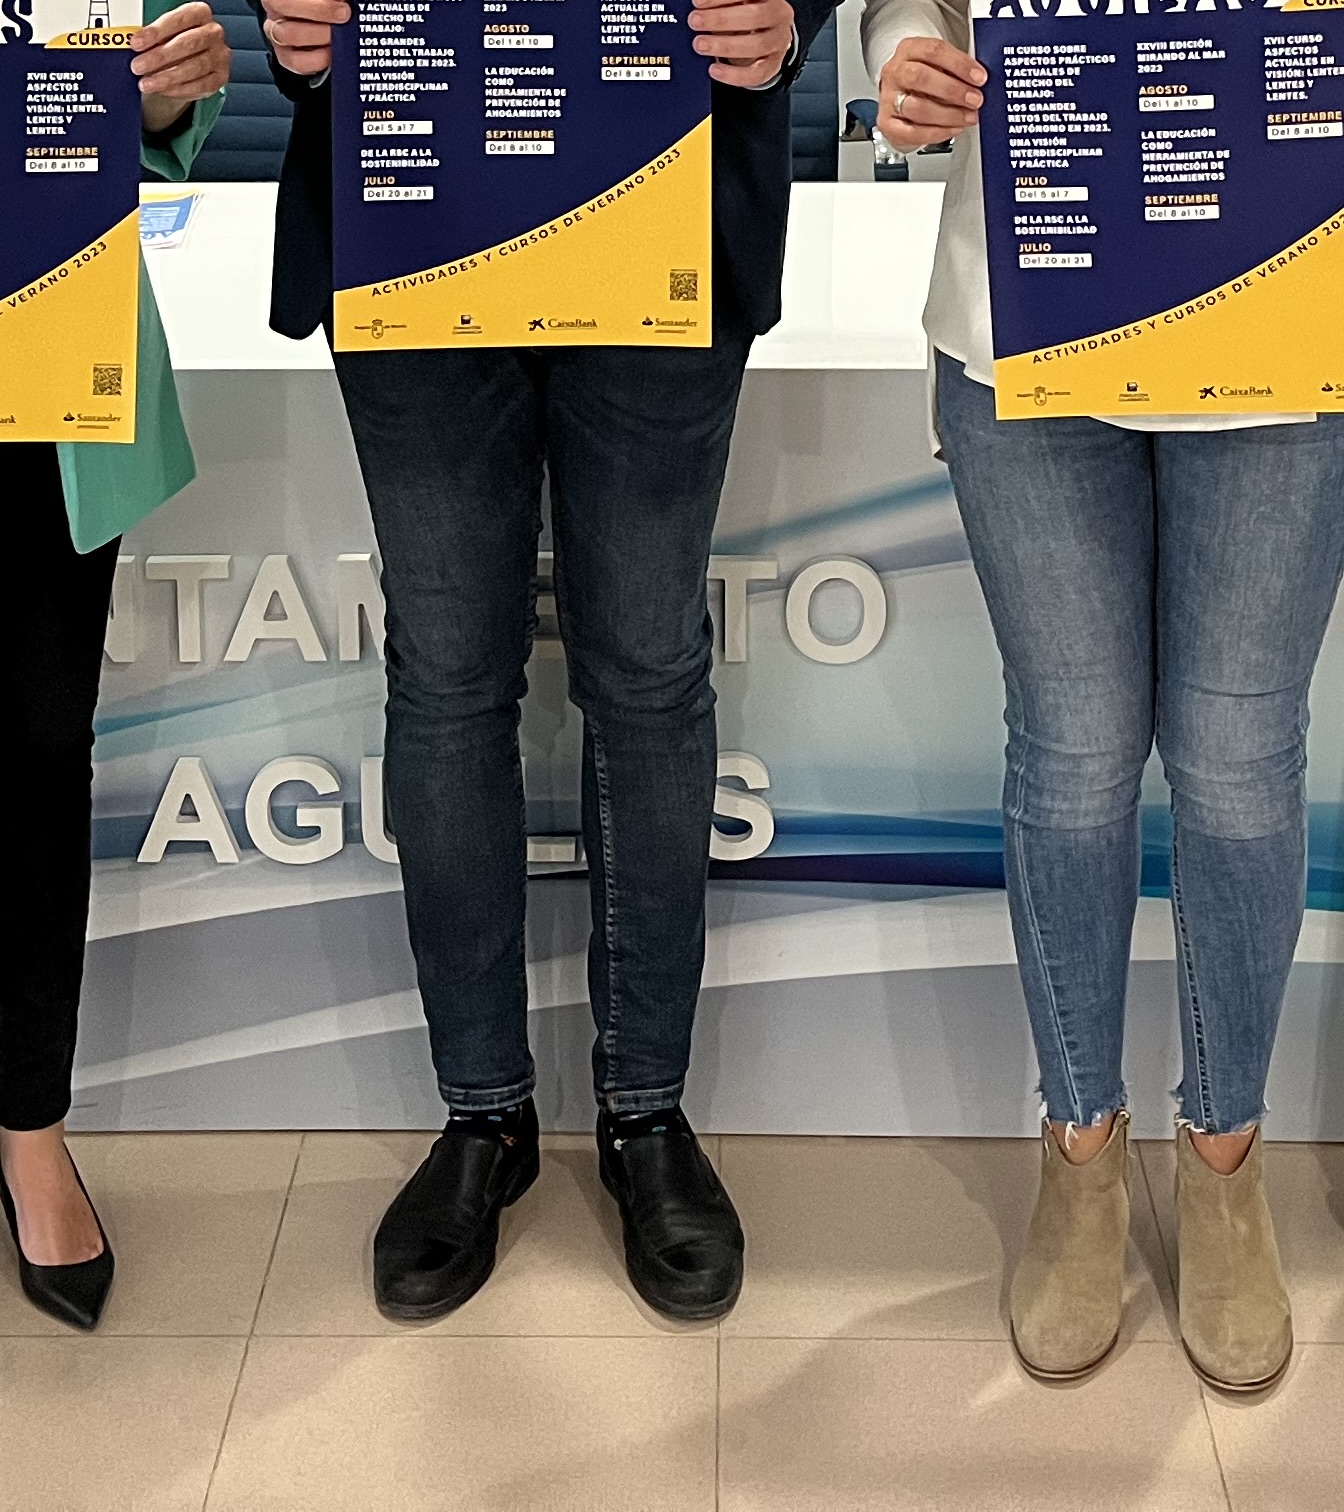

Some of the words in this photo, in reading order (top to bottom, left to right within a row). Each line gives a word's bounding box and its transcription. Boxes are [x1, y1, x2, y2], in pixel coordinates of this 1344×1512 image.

[1263, 36, 1285, 45] XVII
[1287, 34, 1323, 44] CURSO
[1264, 46, 1318, 56] ASPECTOS
[1265, 57, 1318, 67] ACTUALES
[1266, 80, 1305, 90] LENTES
[1306, 80, 1313, 88] Y
[1267, 111, 1342, 122] SEPTIEMBRE
[485, 130, 554, 139] SEPTIEMBRE
[361, 159, 439, 167] SOSTENIBILIDAD
[364, 176, 394, 184] JULIO
[372, 258, 478, 295] ACTIVIDADES
[483, 252, 492, 262] Y
[498, 224, 558, 257] CURSOS
[563, 211, 583, 228] DE
[649, 147, 682, 175] 2023
[73, 240, 107, 268] 2023
[1032, 325, 1142, 364] ACTIVIDADES
[1146, 319, 1156, 329] Y
[1163, 289, 1226, 323] CURSOS
[1231, 275, 1252, 292] DE
